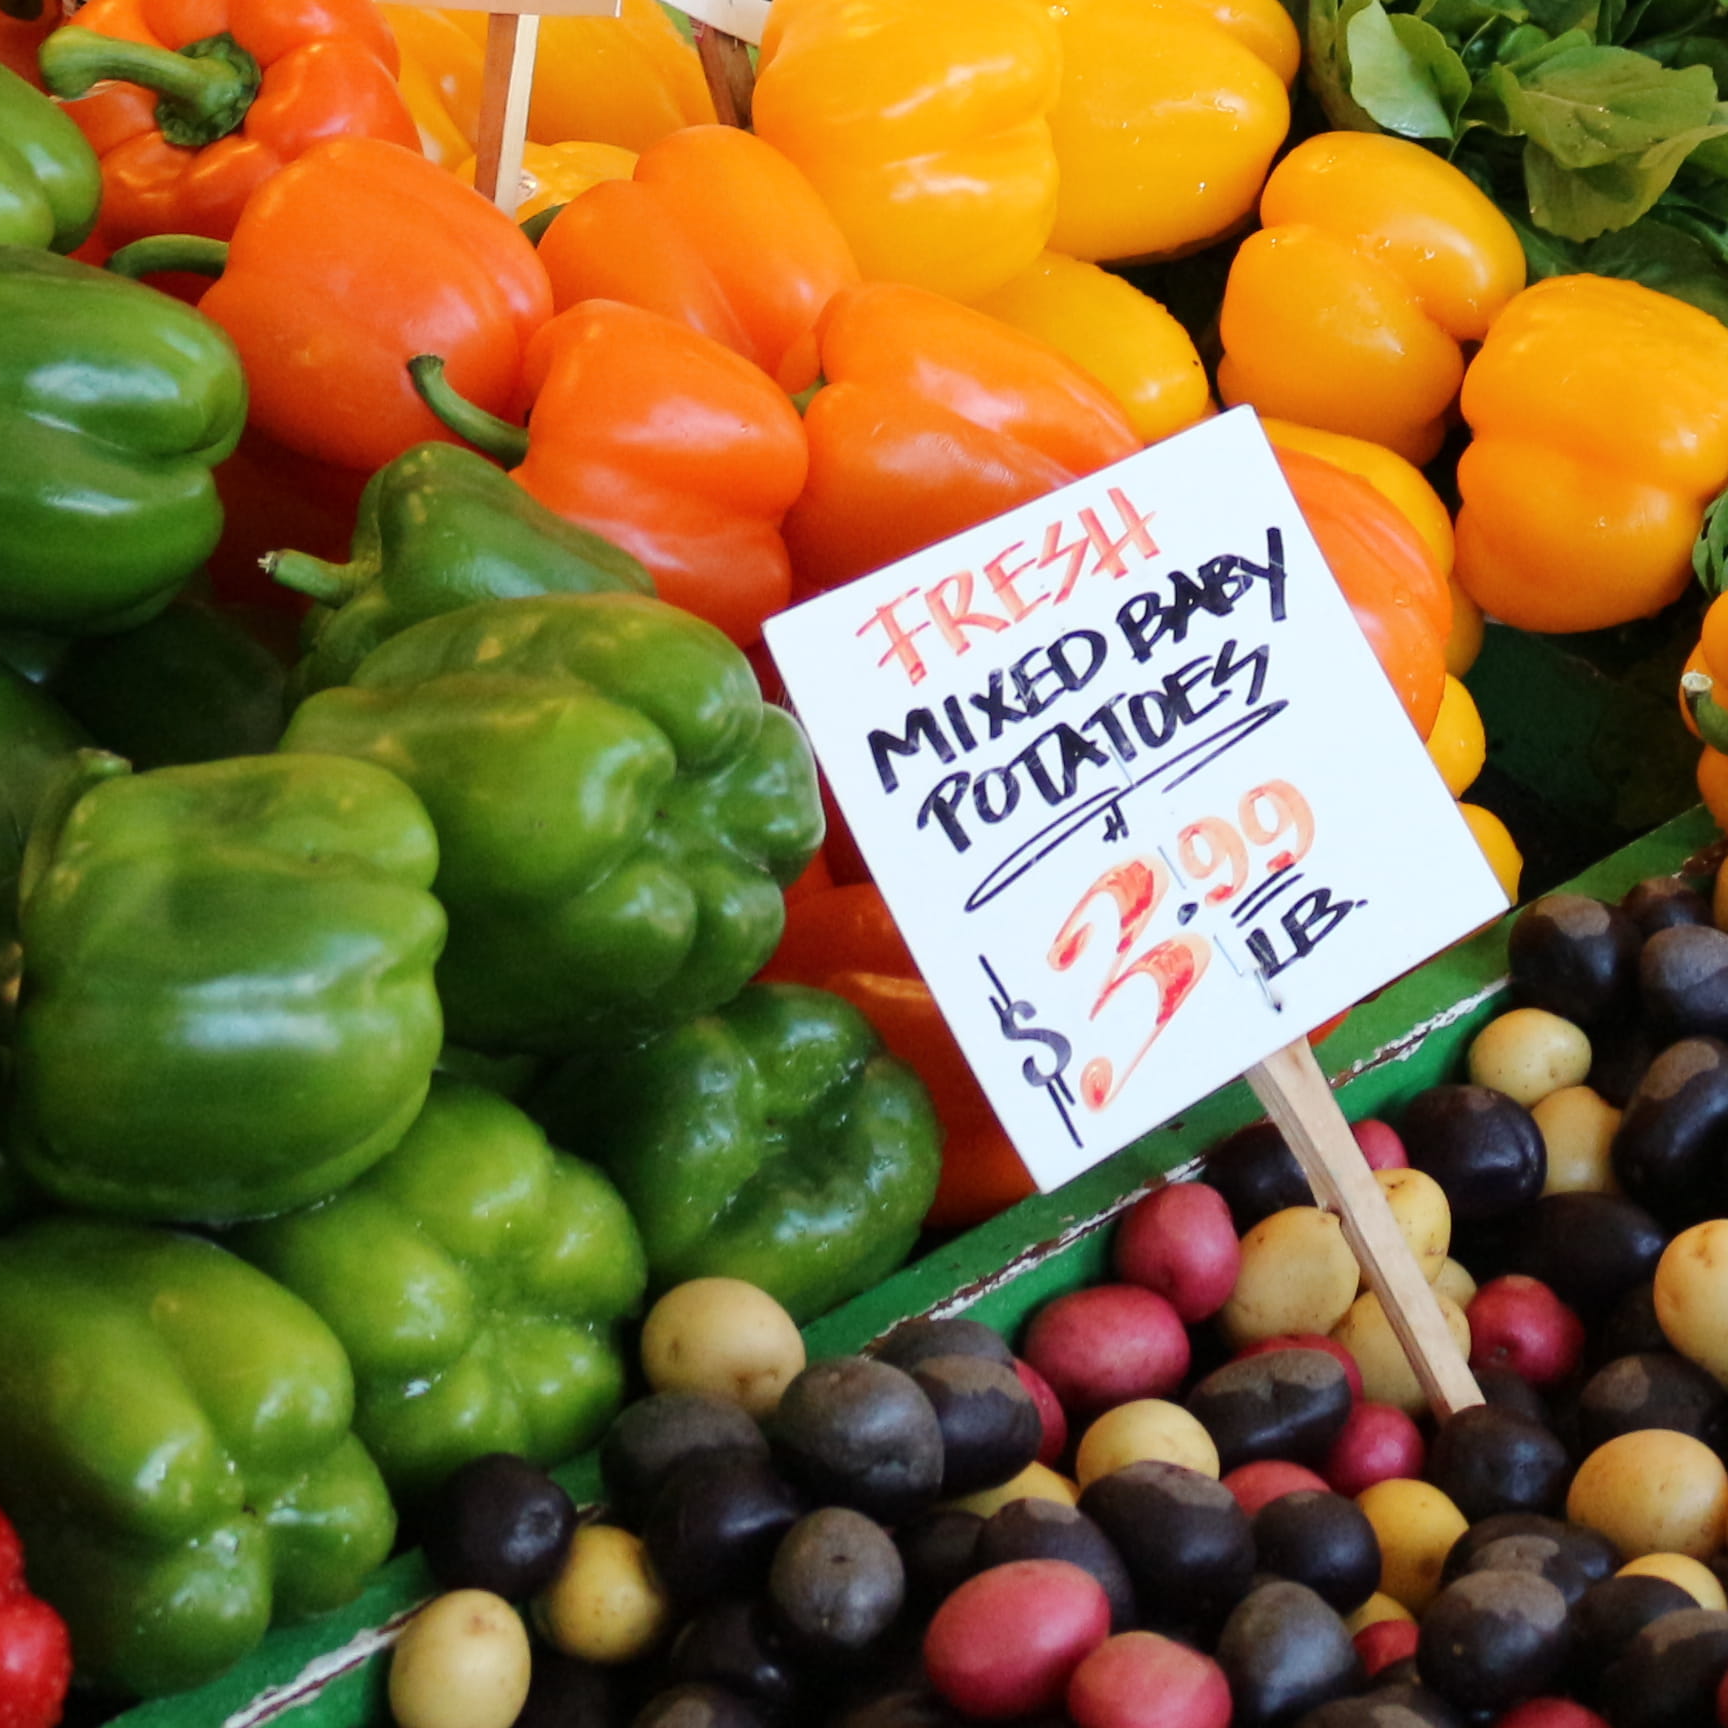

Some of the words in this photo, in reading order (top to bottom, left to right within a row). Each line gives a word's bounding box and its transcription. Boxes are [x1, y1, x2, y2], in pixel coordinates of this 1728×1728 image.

[854, 485, 1163, 688] FRESH
[865, 627, 1109, 794] MIXED
[1114, 526, 1289, 665] BABY
[915, 638, 1272, 855] POTATOES
[977, 778, 1317, 1149] $3.99
[1243, 886, 1370, 982] LB.
